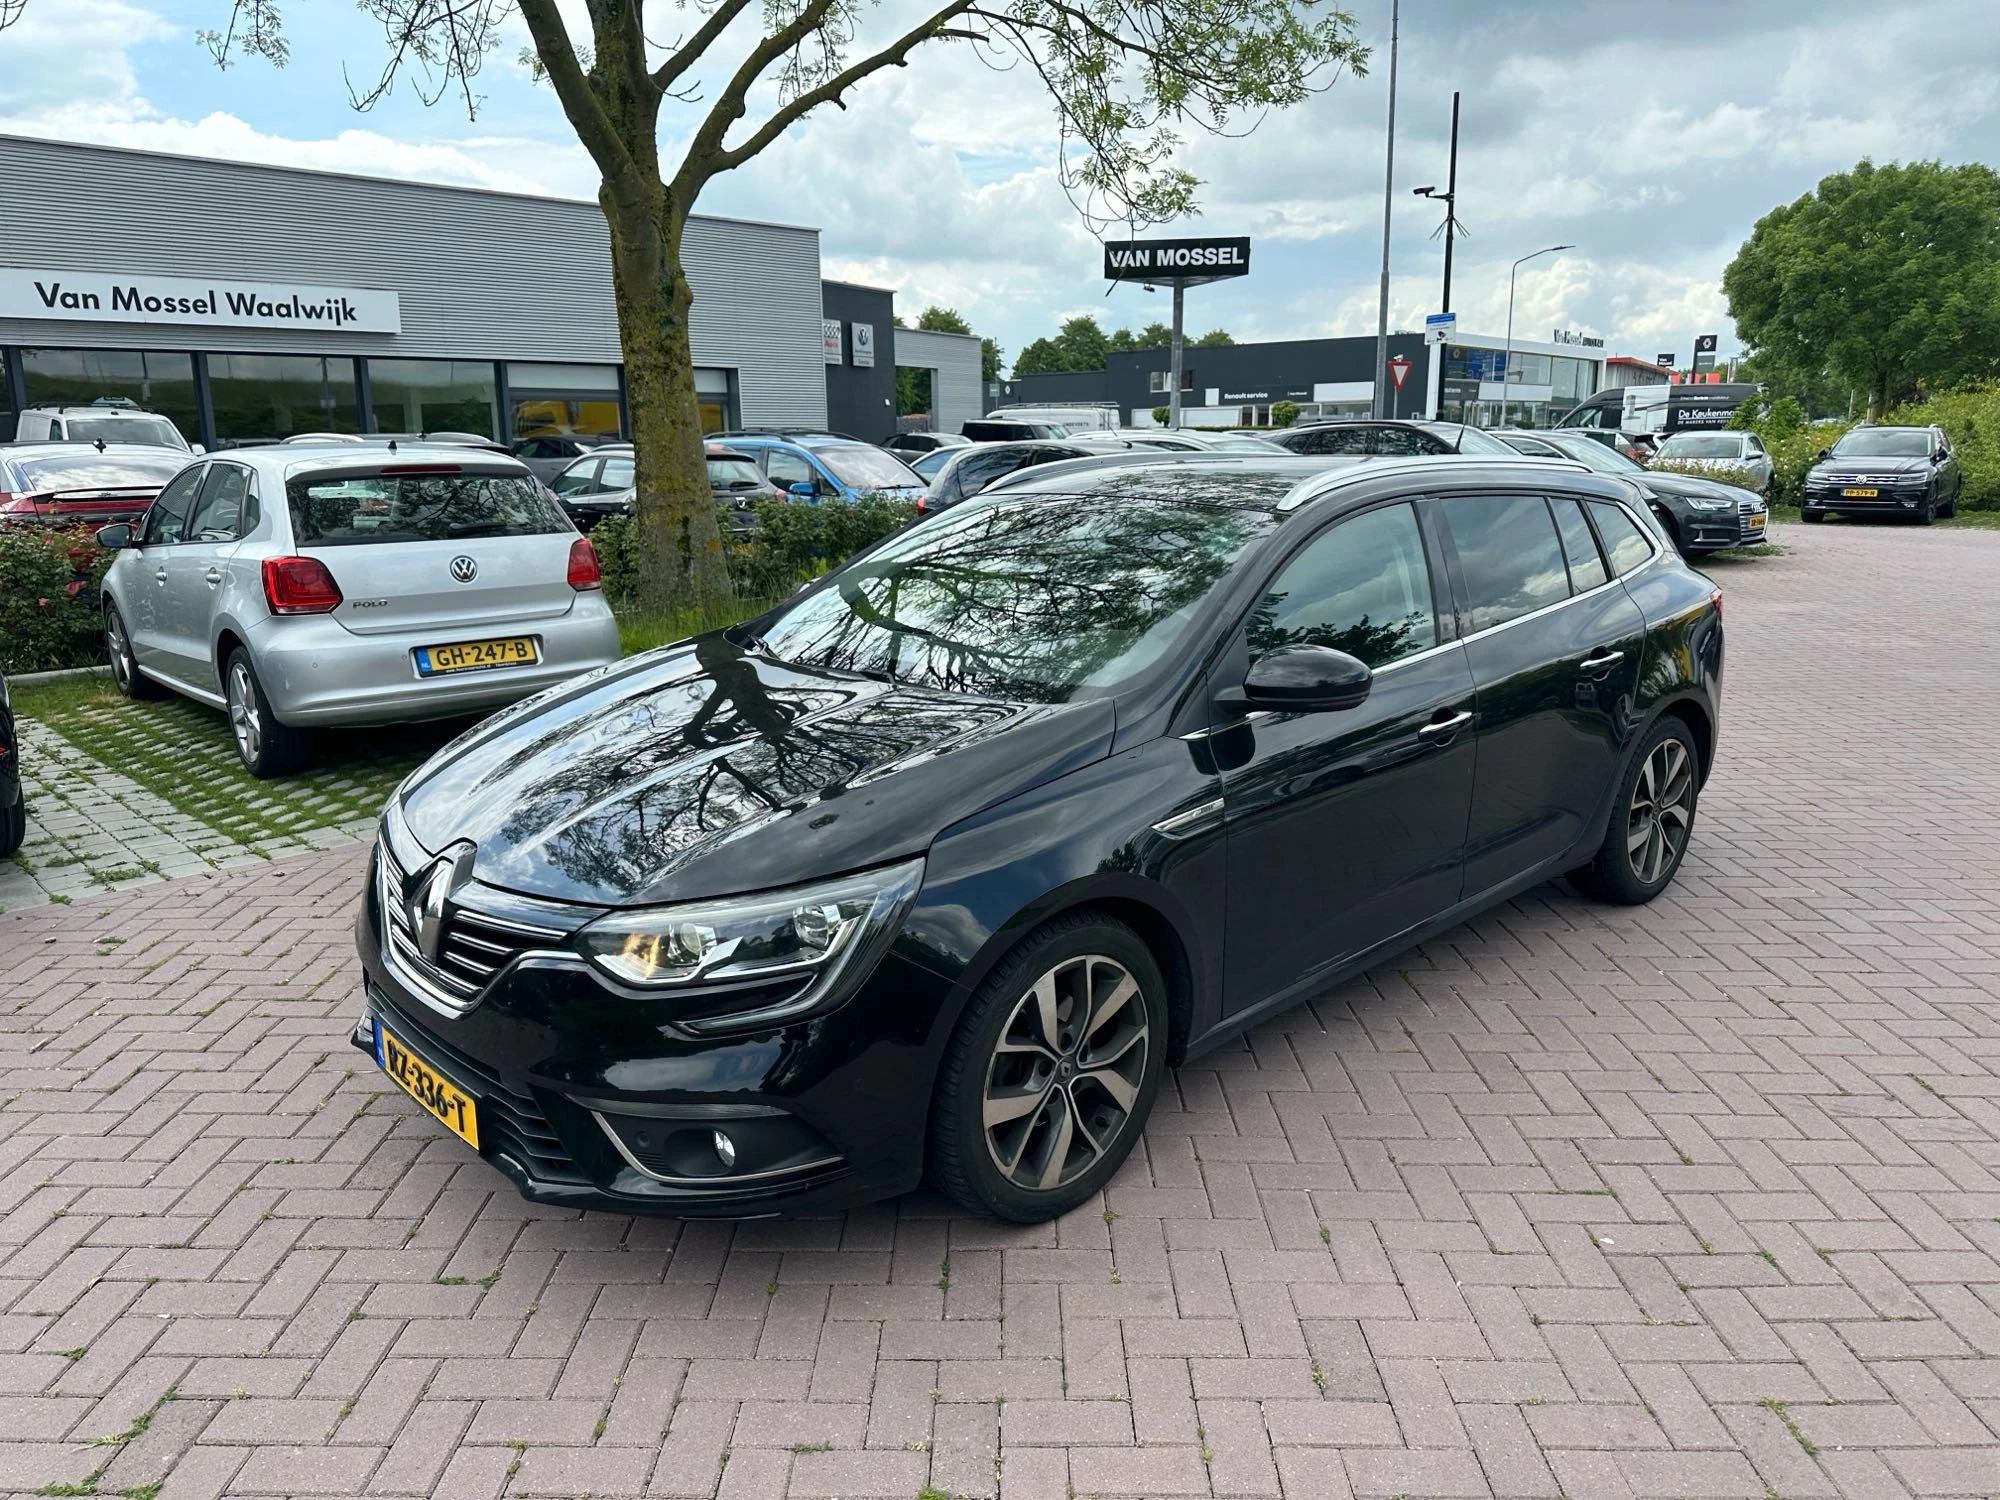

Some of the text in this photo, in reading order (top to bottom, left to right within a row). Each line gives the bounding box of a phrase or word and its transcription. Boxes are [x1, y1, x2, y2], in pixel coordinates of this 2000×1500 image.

[1109, 247, 1245, 268] VAN MOSSEL
[34, 281, 357, 326] Van Mossel Waalwijk
[1246, 391, 1268, 399] service
[1678, 409, 1690, 418] De
[352, 600, 388, 609] POLO
[436, 642, 528, 667] GH-247-B
